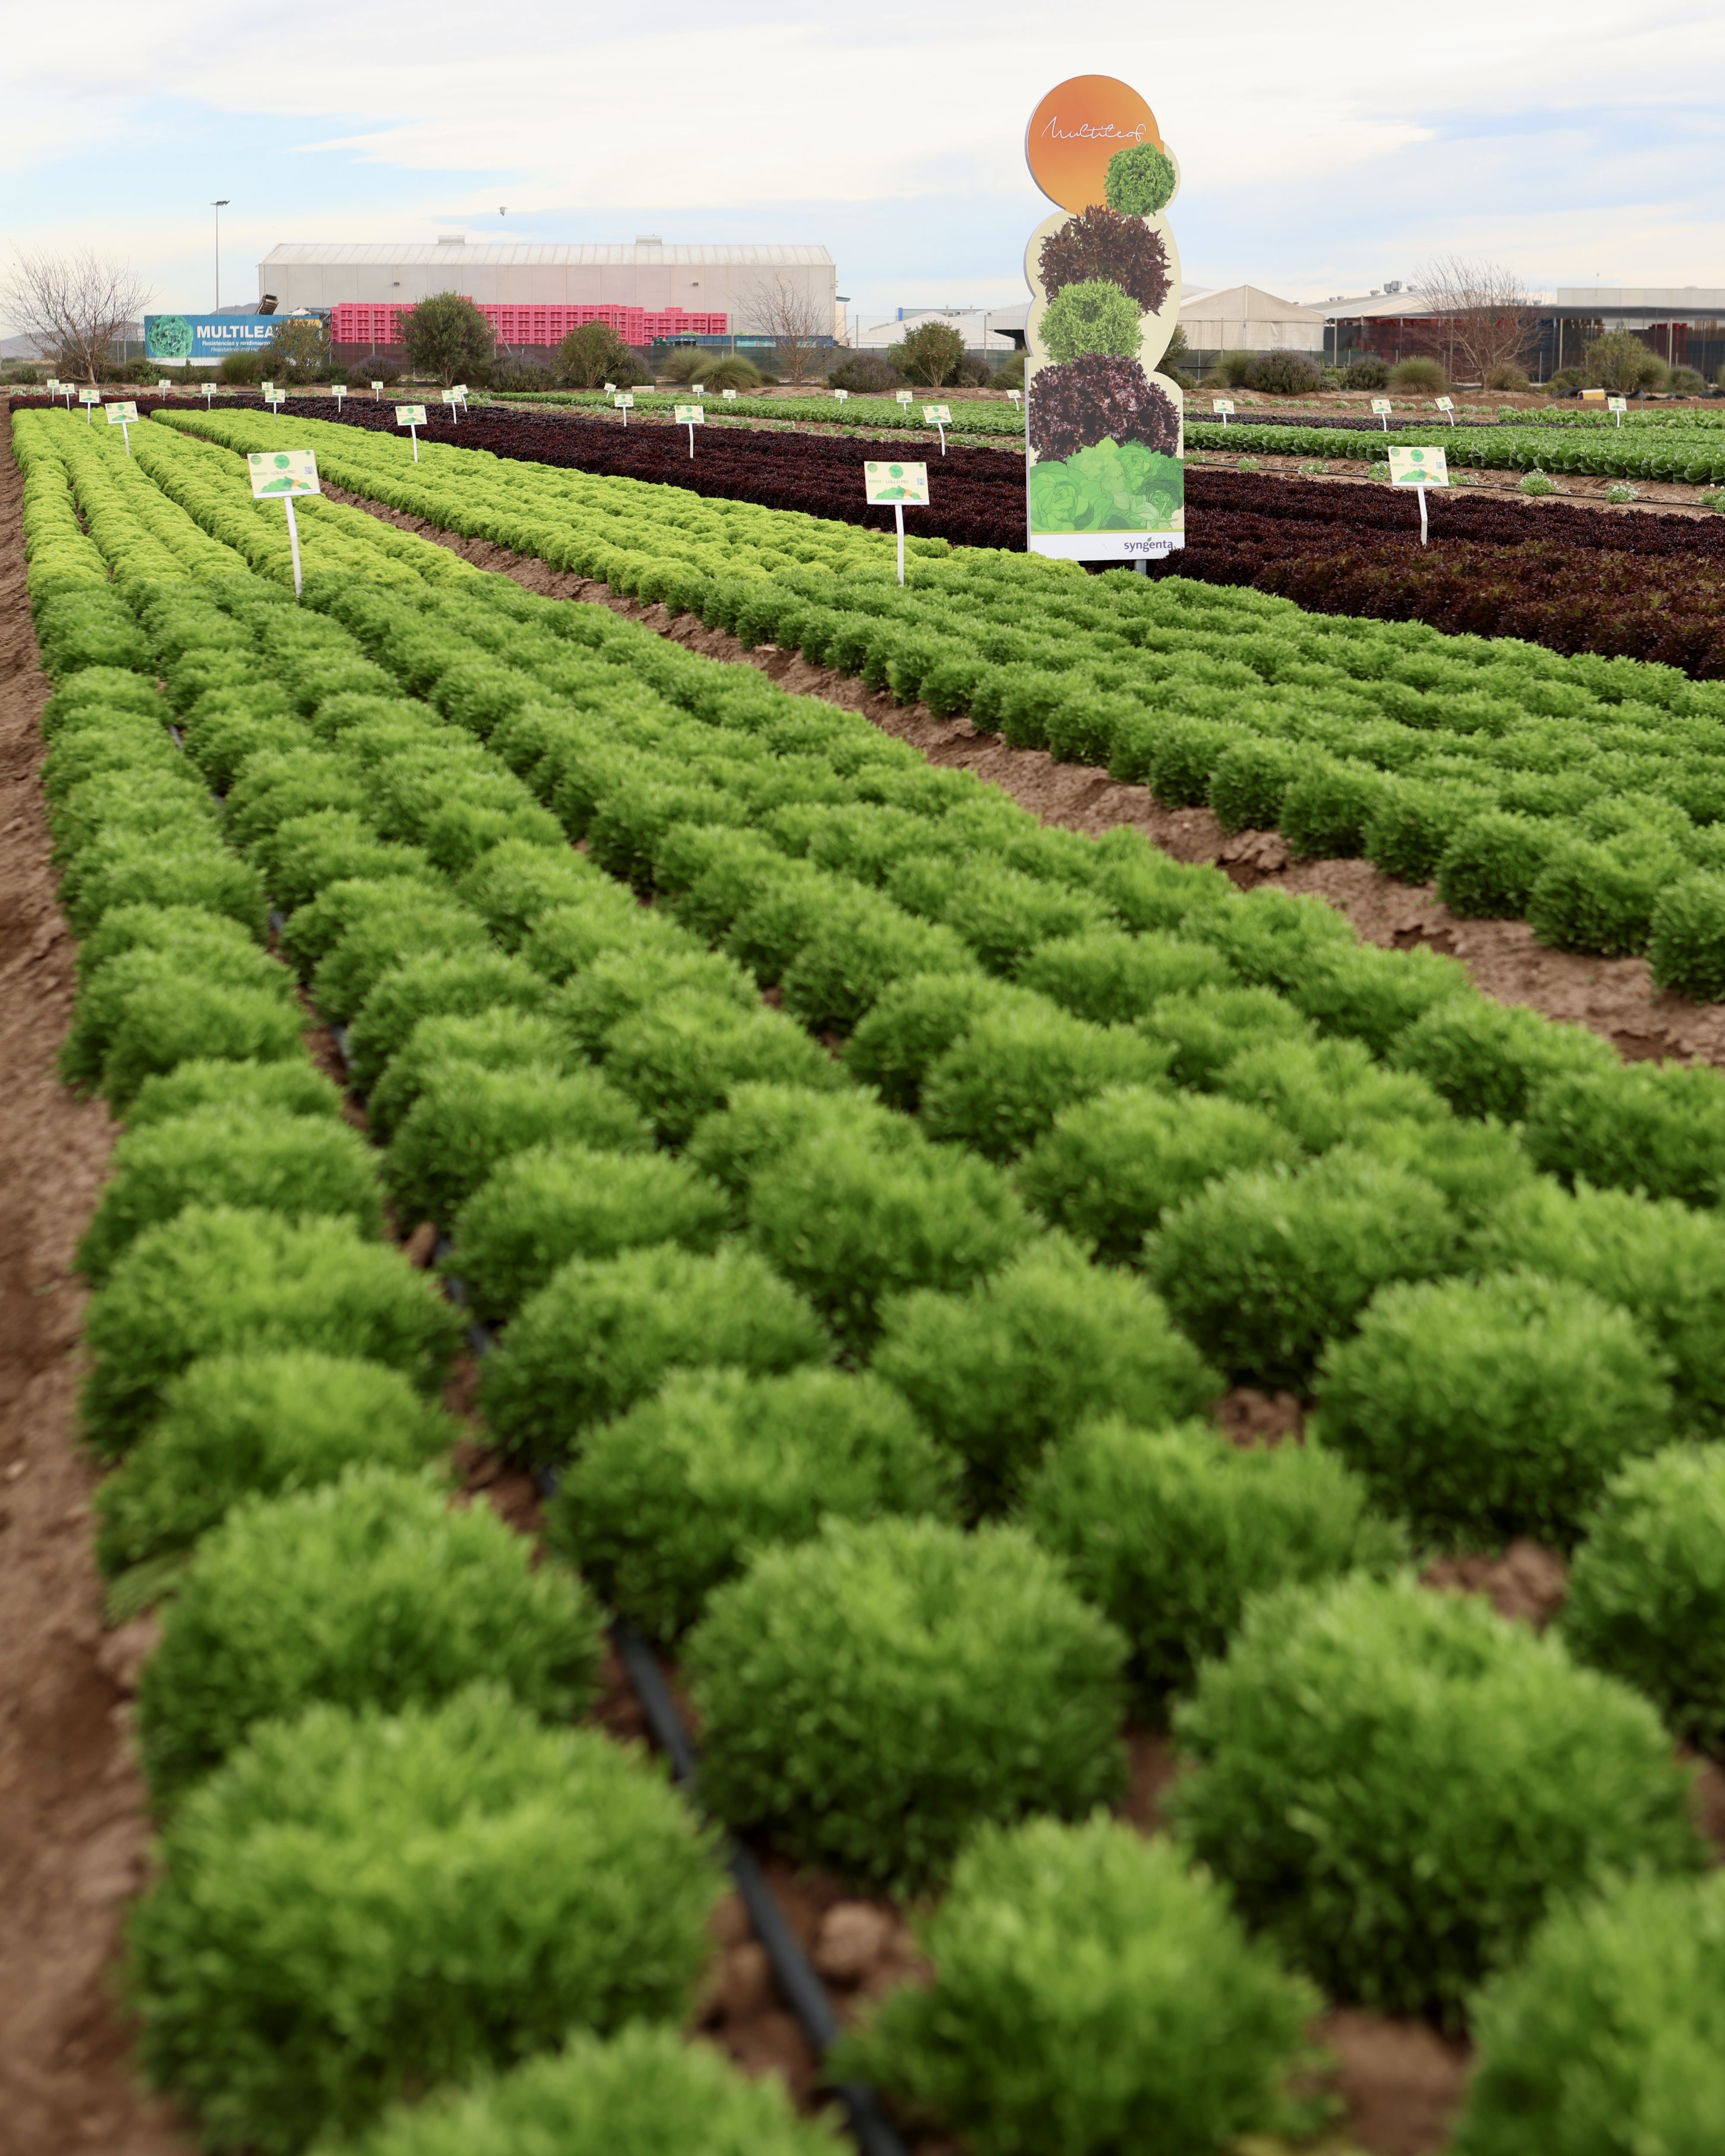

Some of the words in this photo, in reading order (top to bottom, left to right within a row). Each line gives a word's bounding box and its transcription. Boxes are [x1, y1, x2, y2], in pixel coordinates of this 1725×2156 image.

[1041, 116, 1146, 142] Multileaf
[197, 325, 281, 338] MULTILEA
[1124, 540, 1173, 552] syngenta
